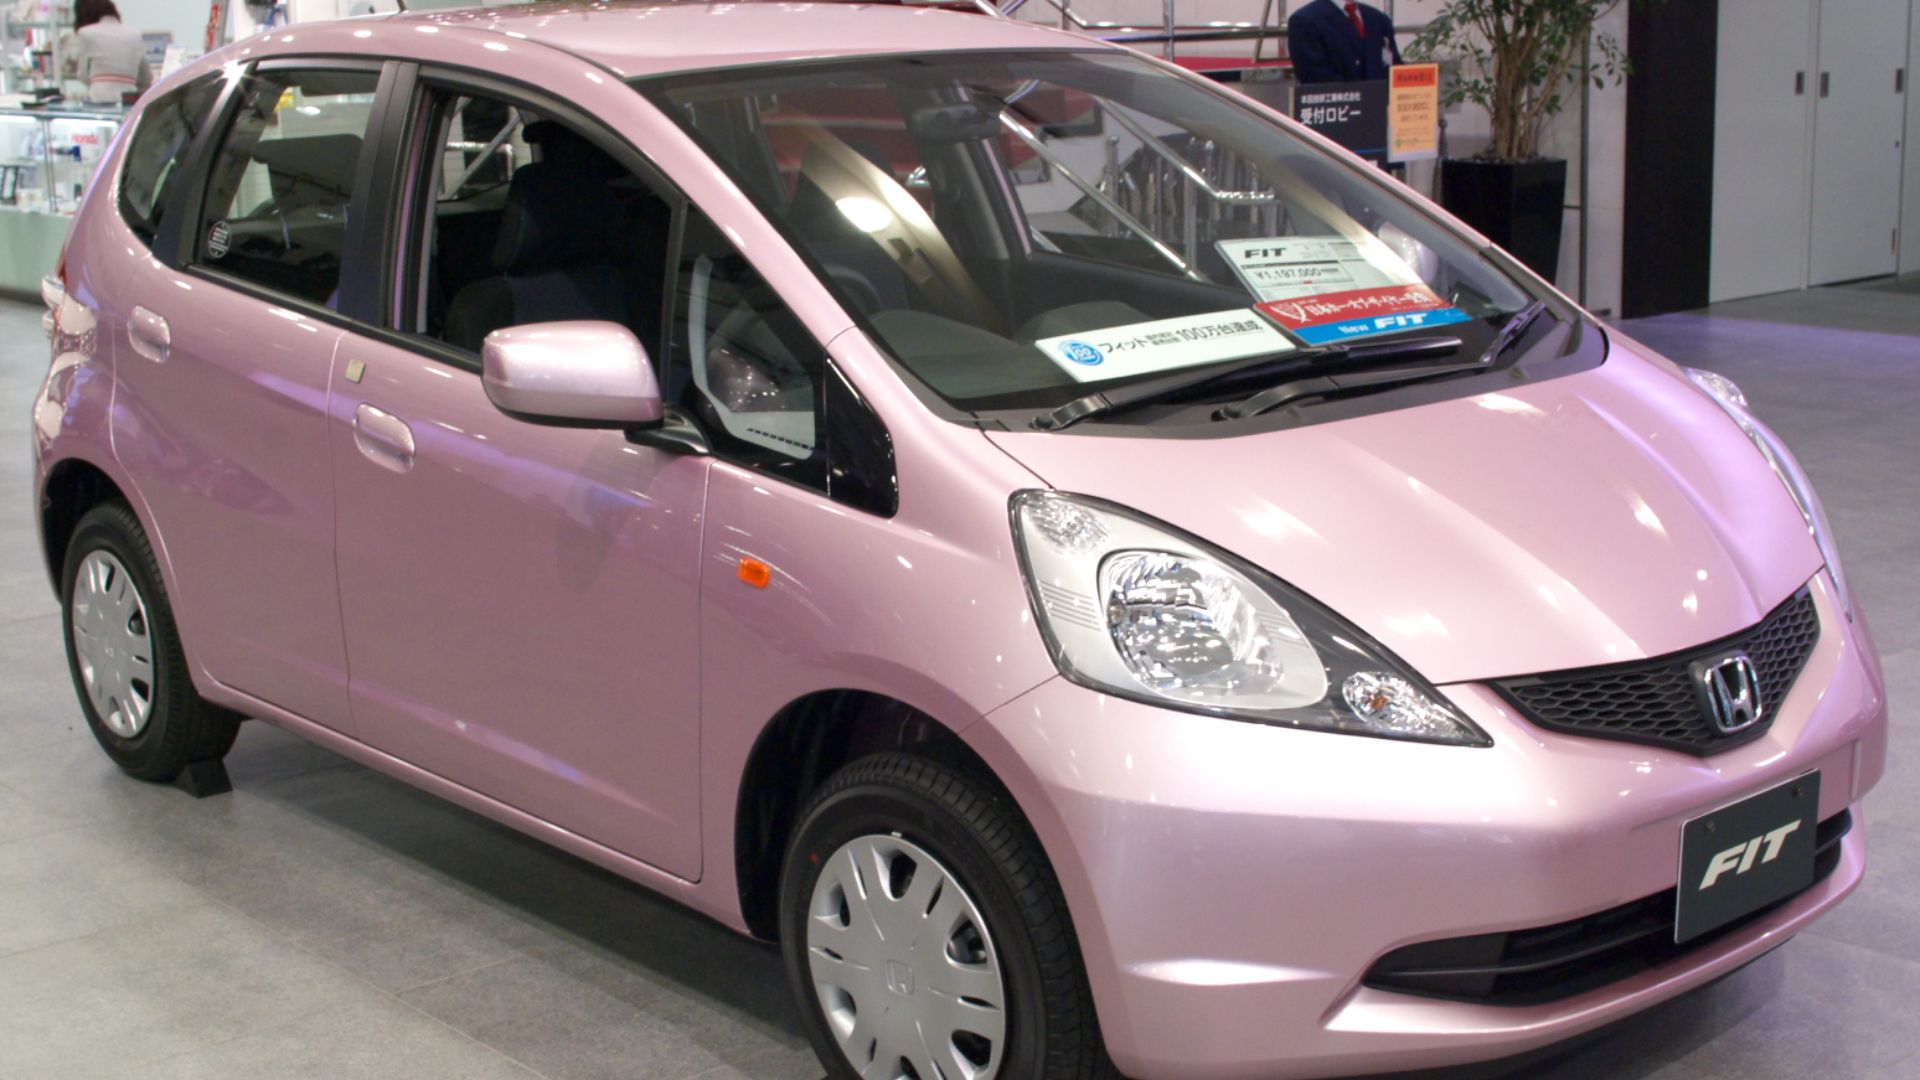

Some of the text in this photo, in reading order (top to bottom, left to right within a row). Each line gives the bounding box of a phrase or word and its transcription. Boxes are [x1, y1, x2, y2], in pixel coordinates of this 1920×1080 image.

[1301, 105, 1361, 125] 受付ロビー
[1244, 247, 1287, 259] FIT
[1374, 313, 1428, 330] FIT
[1098, 336, 1147, 353] フィット
[1698, 819, 1802, 890] FIT
